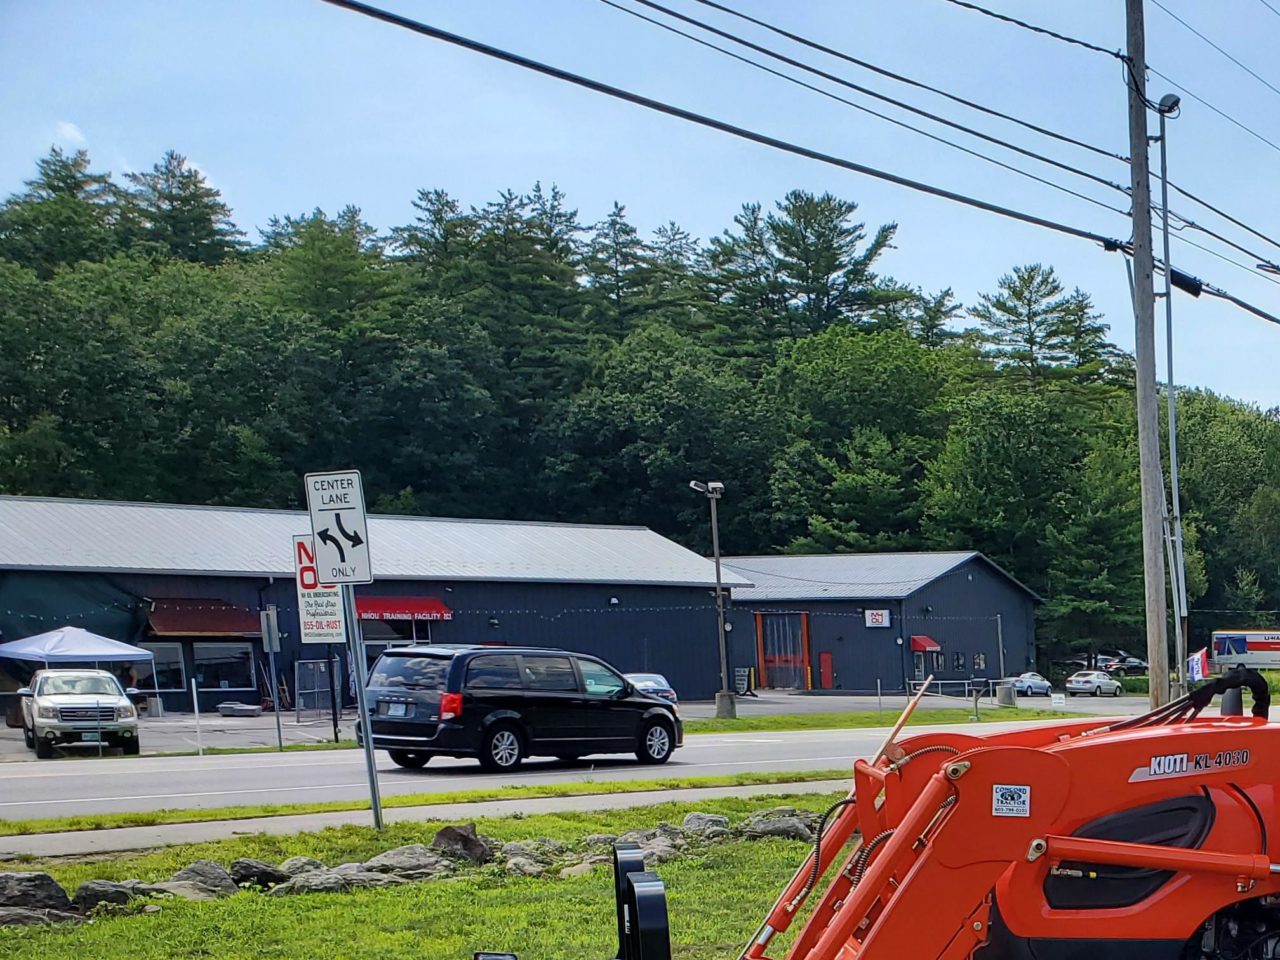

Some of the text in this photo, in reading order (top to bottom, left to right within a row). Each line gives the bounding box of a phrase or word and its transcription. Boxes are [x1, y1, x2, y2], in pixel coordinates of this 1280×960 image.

[313, 478, 354, 491] CENTER
[321, 493, 350, 505] LANE
[297, 541, 314, 565] N
[331, 566, 356, 578] ONLY
[1150, 750, 1249, 776] KIOTI KL 4030
[995, 786, 1027, 795] CONCORD
[996, 798, 1026, 806] TRACTOR
